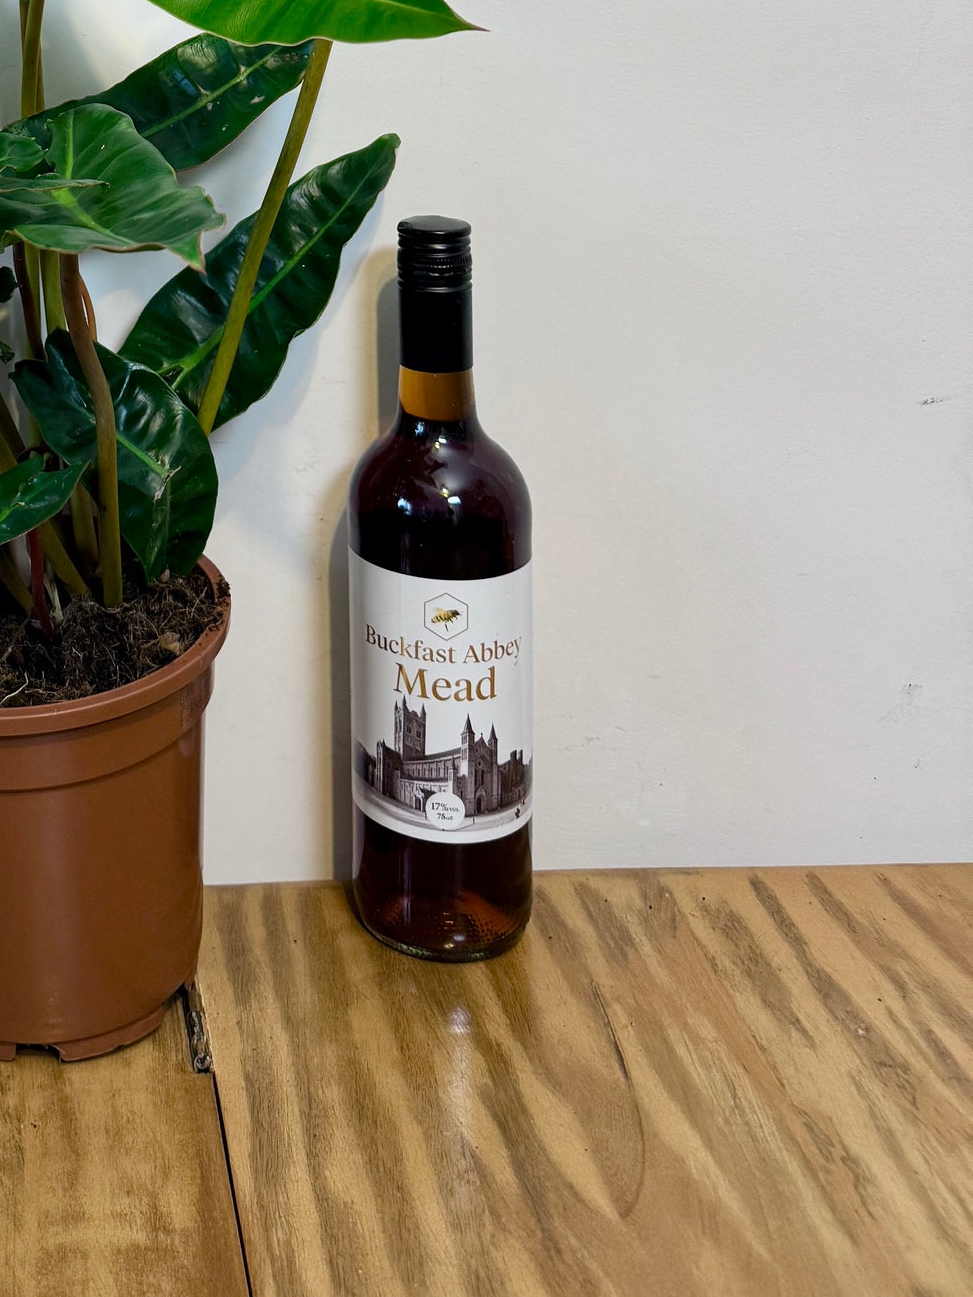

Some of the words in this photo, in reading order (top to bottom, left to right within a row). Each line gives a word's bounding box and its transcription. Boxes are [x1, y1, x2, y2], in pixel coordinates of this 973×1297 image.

[365, 623, 456, 664] Buckfast
[462, 636, 522, 664] Abbey
[393, 662, 497, 702] Mead
